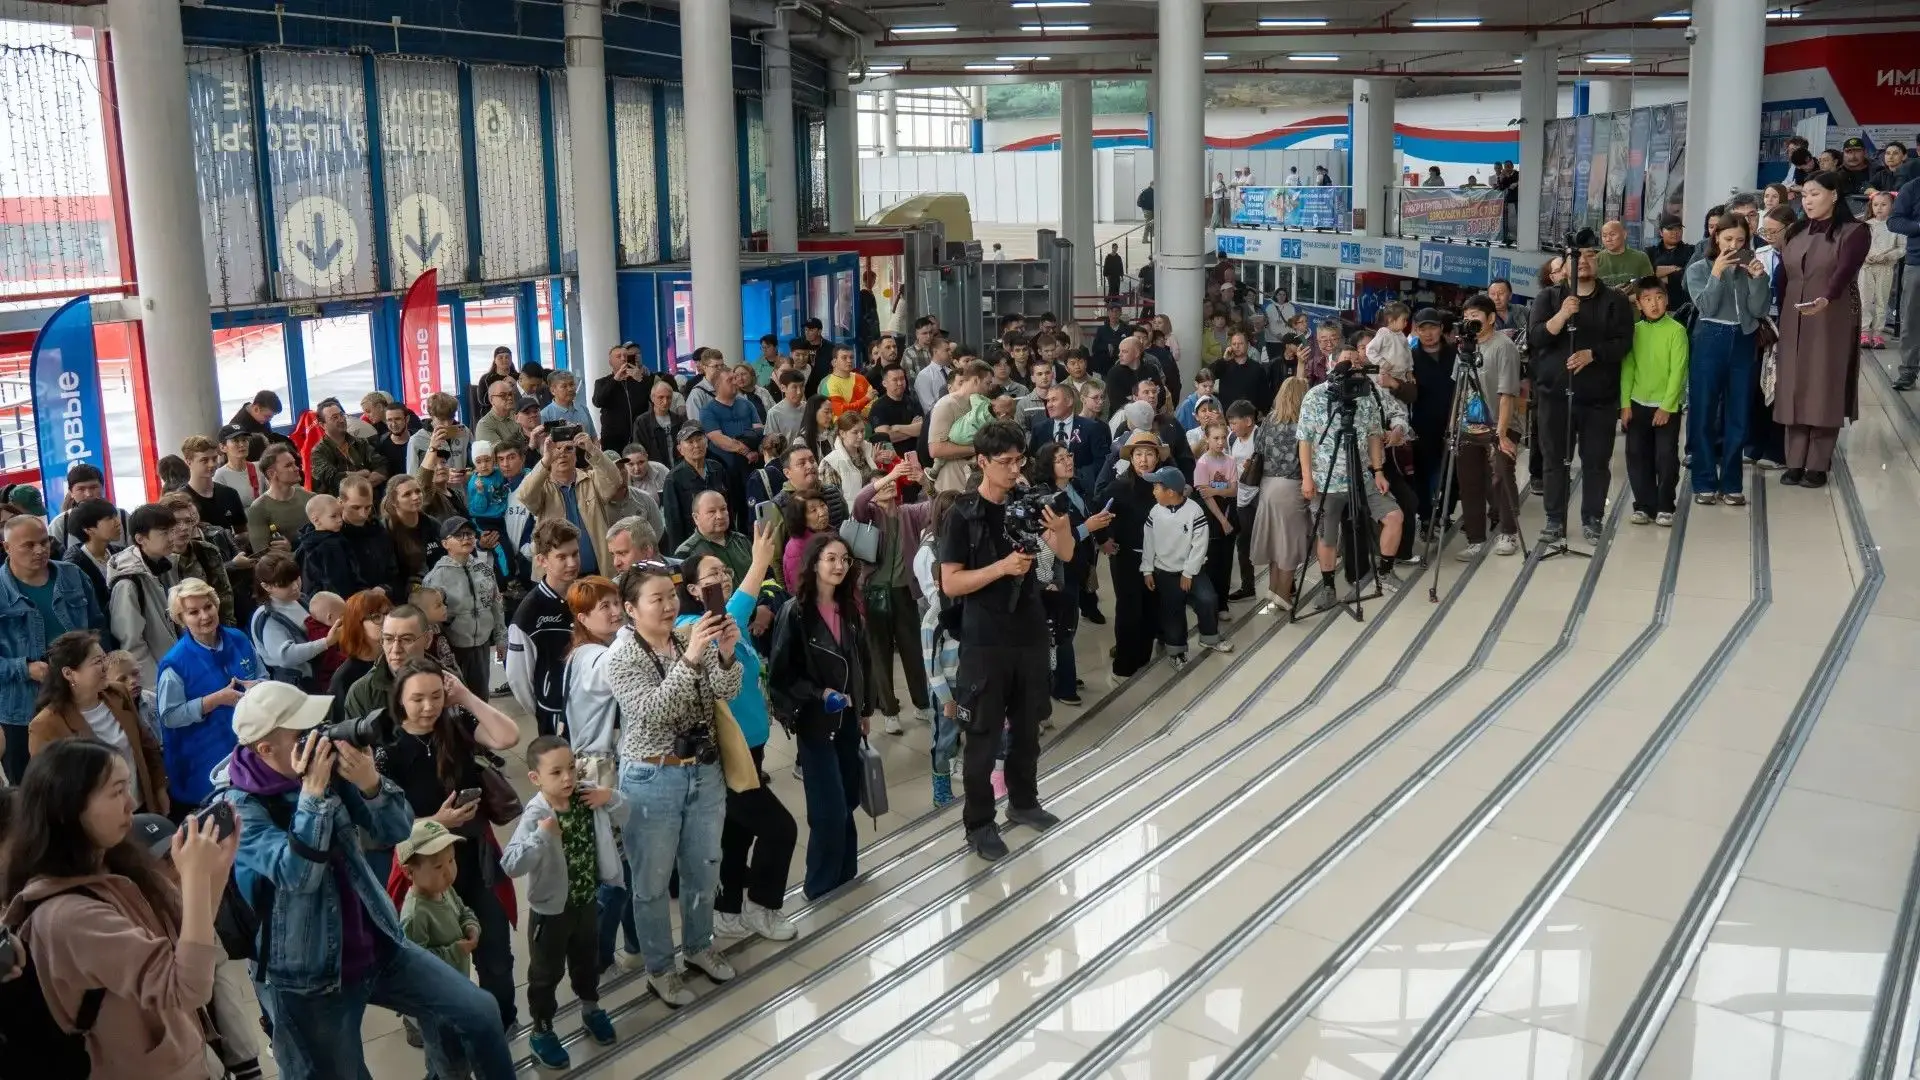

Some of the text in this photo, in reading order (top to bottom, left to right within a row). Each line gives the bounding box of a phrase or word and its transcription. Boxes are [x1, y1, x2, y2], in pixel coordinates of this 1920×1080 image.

[1877, 69, 1920, 87] ИМ
[415, 328, 432, 417] ервые
[509, 506, 526, 516] SIA
[535, 613, 563, 629] good
